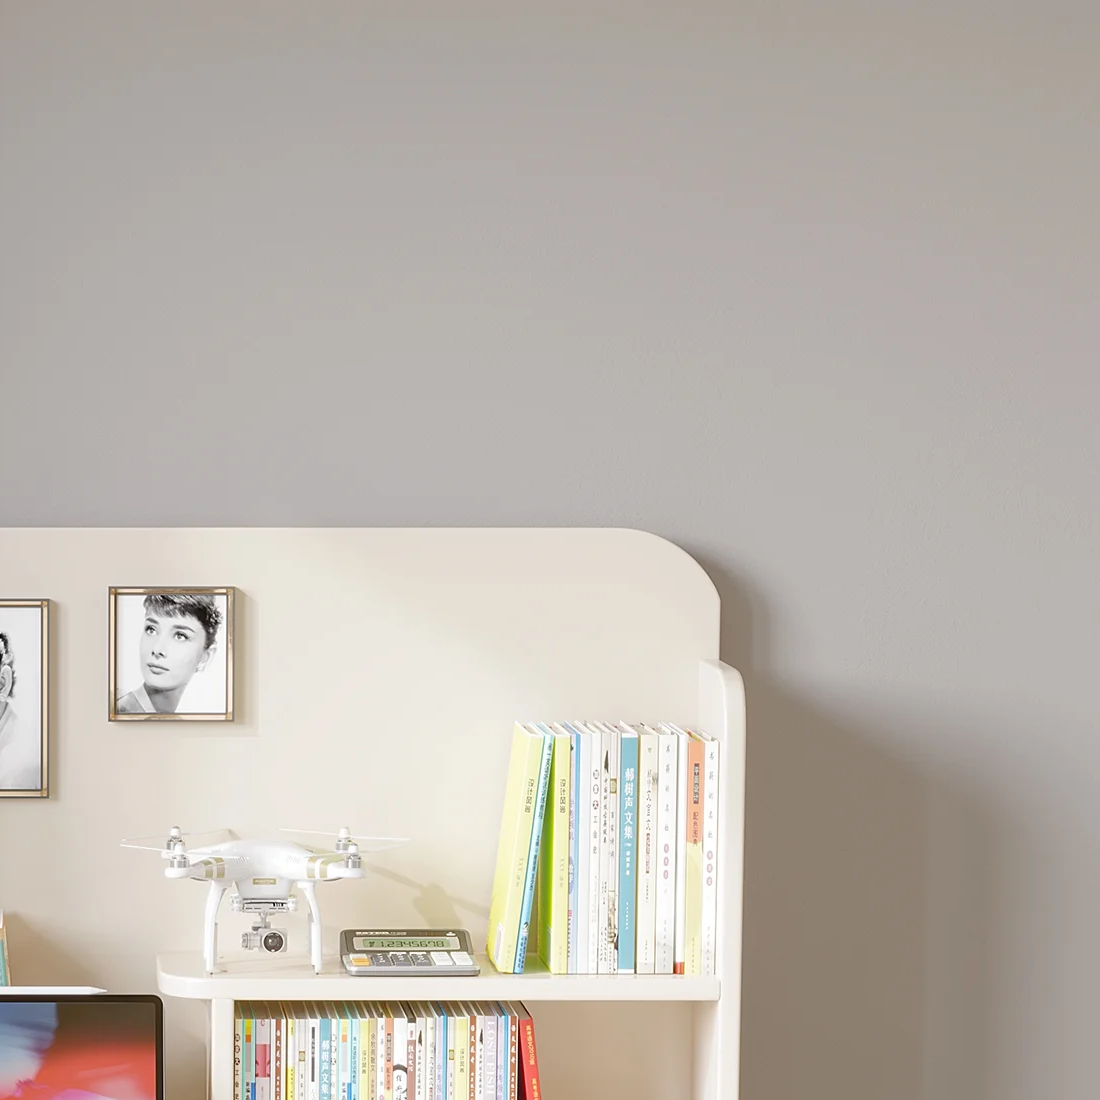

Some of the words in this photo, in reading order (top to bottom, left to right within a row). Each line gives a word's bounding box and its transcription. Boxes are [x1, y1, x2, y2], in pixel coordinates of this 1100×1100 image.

[623, 768, 635, 840] 郝树声文集
[487, 1020, 495, 1059] LOST
[321, 1040, 329, 1094] 郝树声文集
[486, 1062, 494, 1094] FISH
